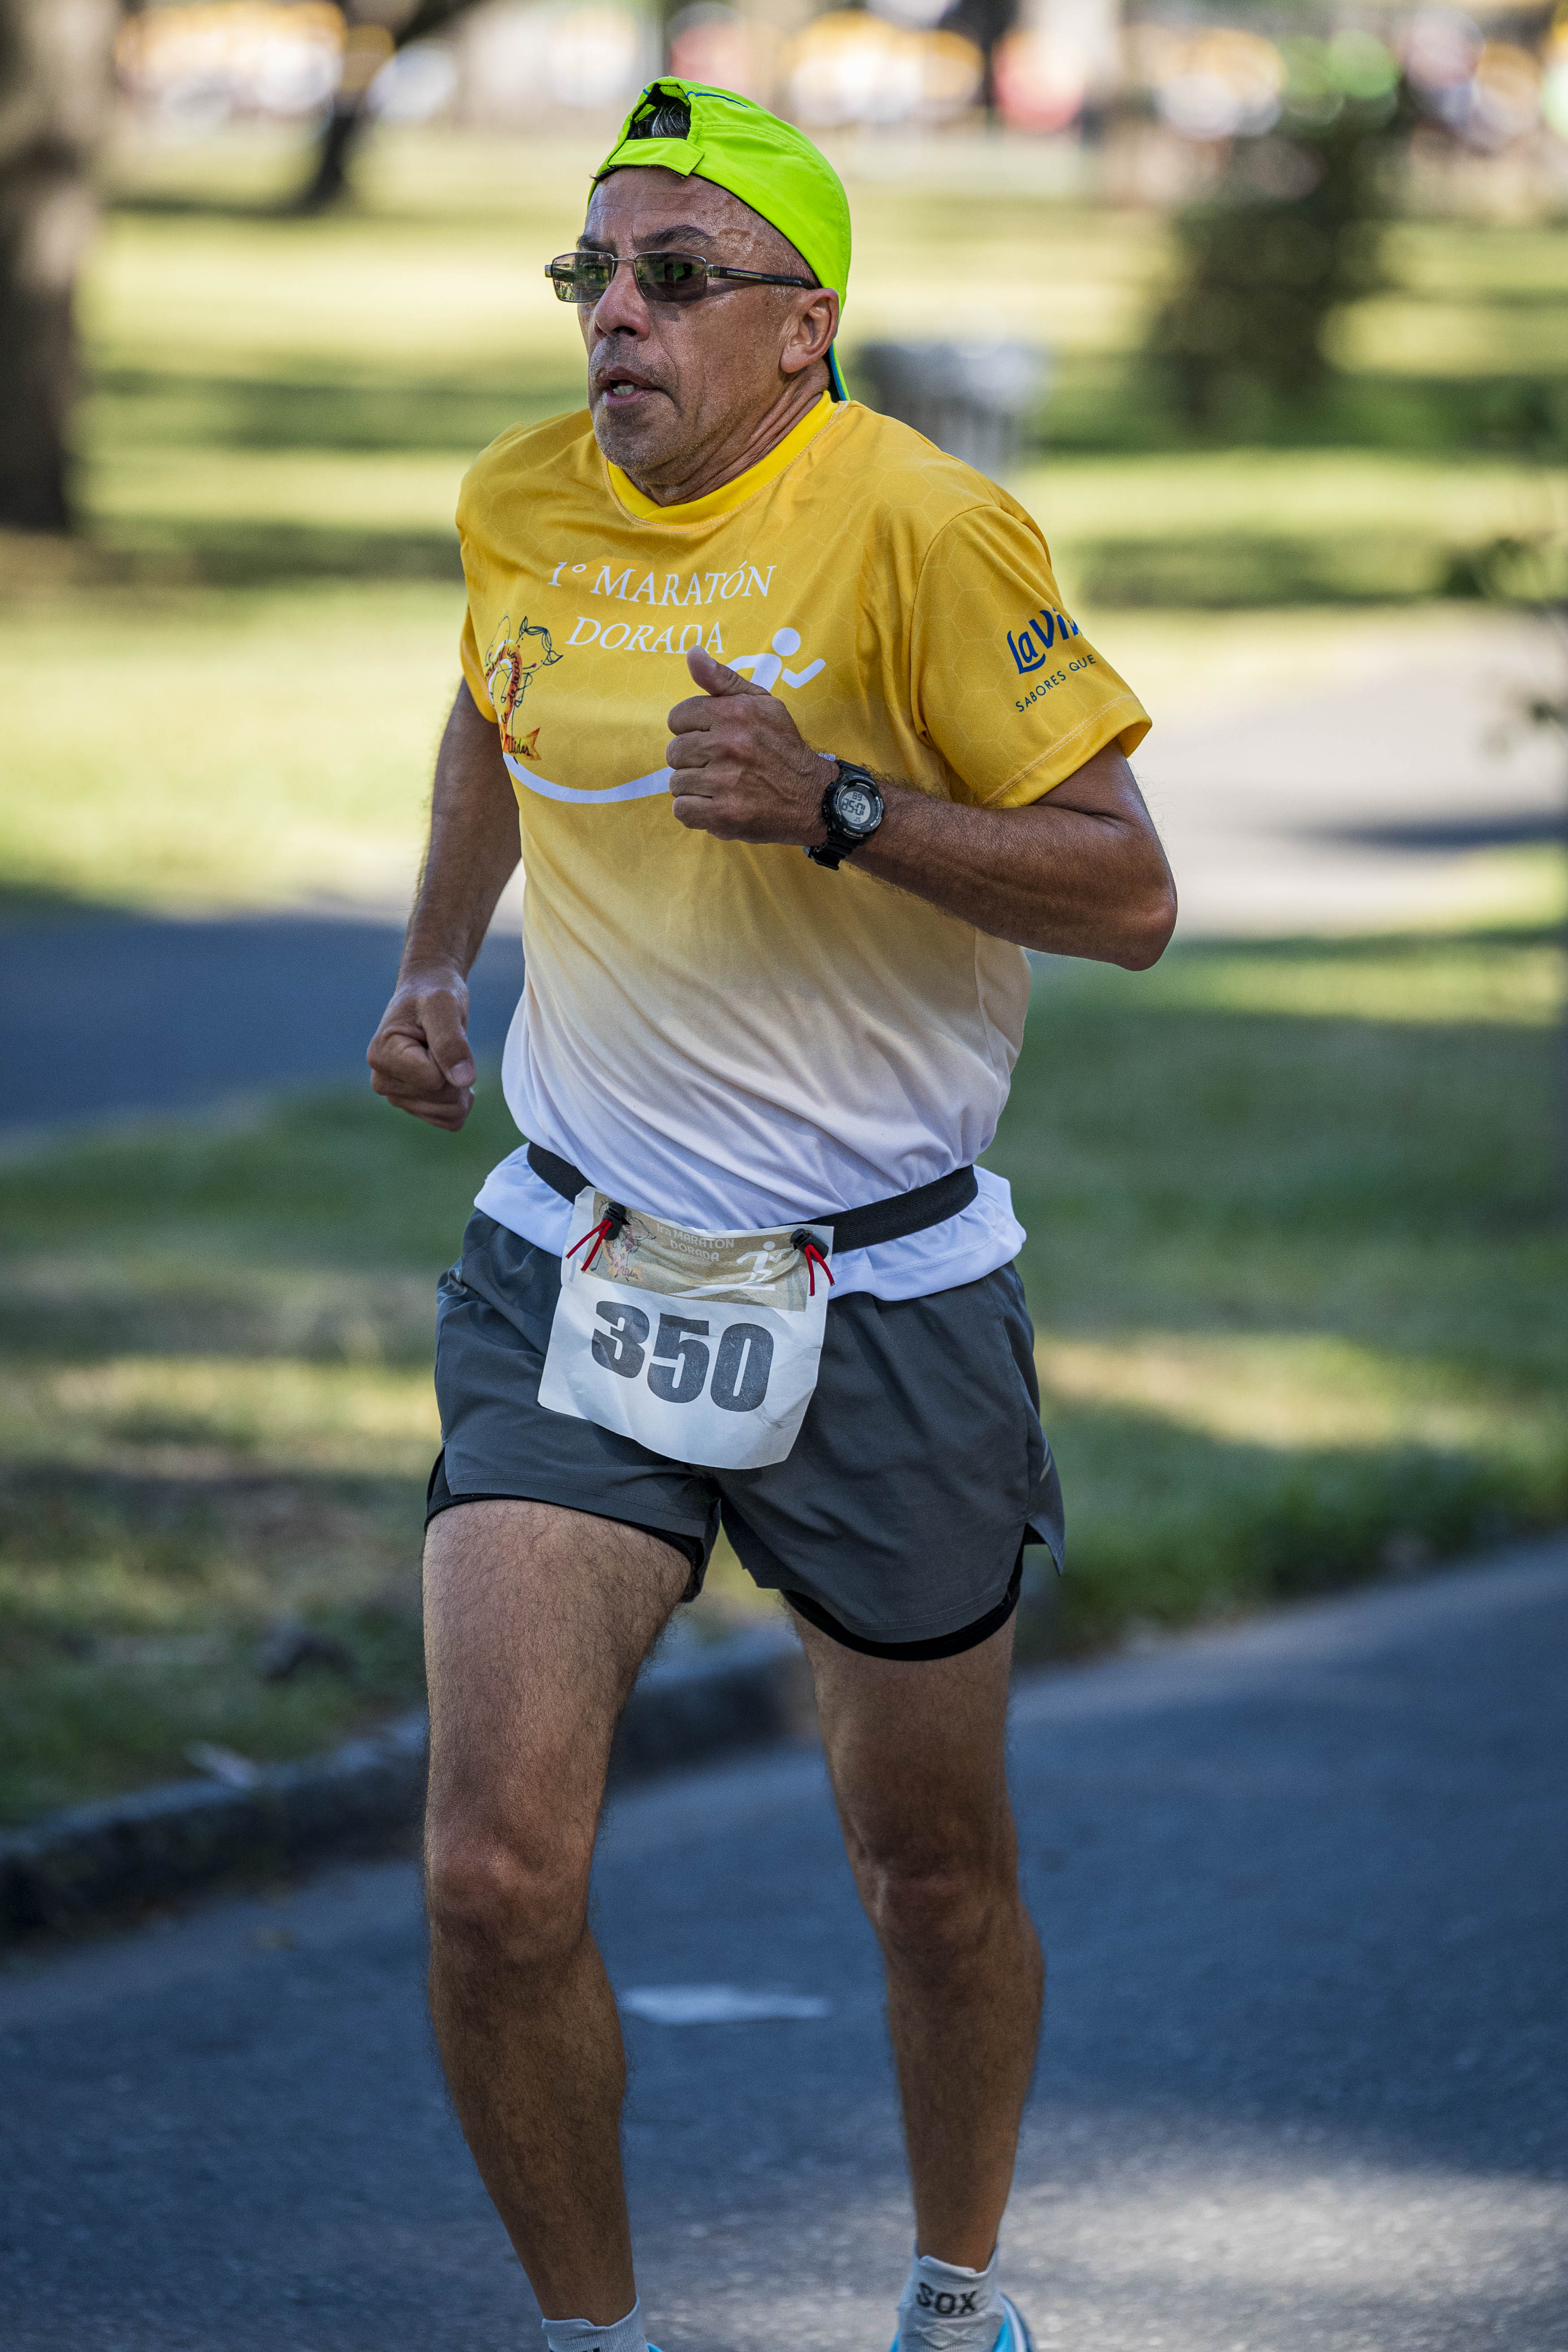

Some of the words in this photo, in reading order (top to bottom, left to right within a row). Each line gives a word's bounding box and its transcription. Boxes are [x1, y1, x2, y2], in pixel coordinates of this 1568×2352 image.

[590, 561, 777, 606] MARATÓN
[565, 617, 725, 653] DORADA
[1016, 670, 1066, 712] SABORES
[1069, 654, 1096, 671] QUE
[671, 1239, 720, 1262] DORADA
[591, 1300, 774, 1412] 350
[916, 2282, 977, 2315] SOX
